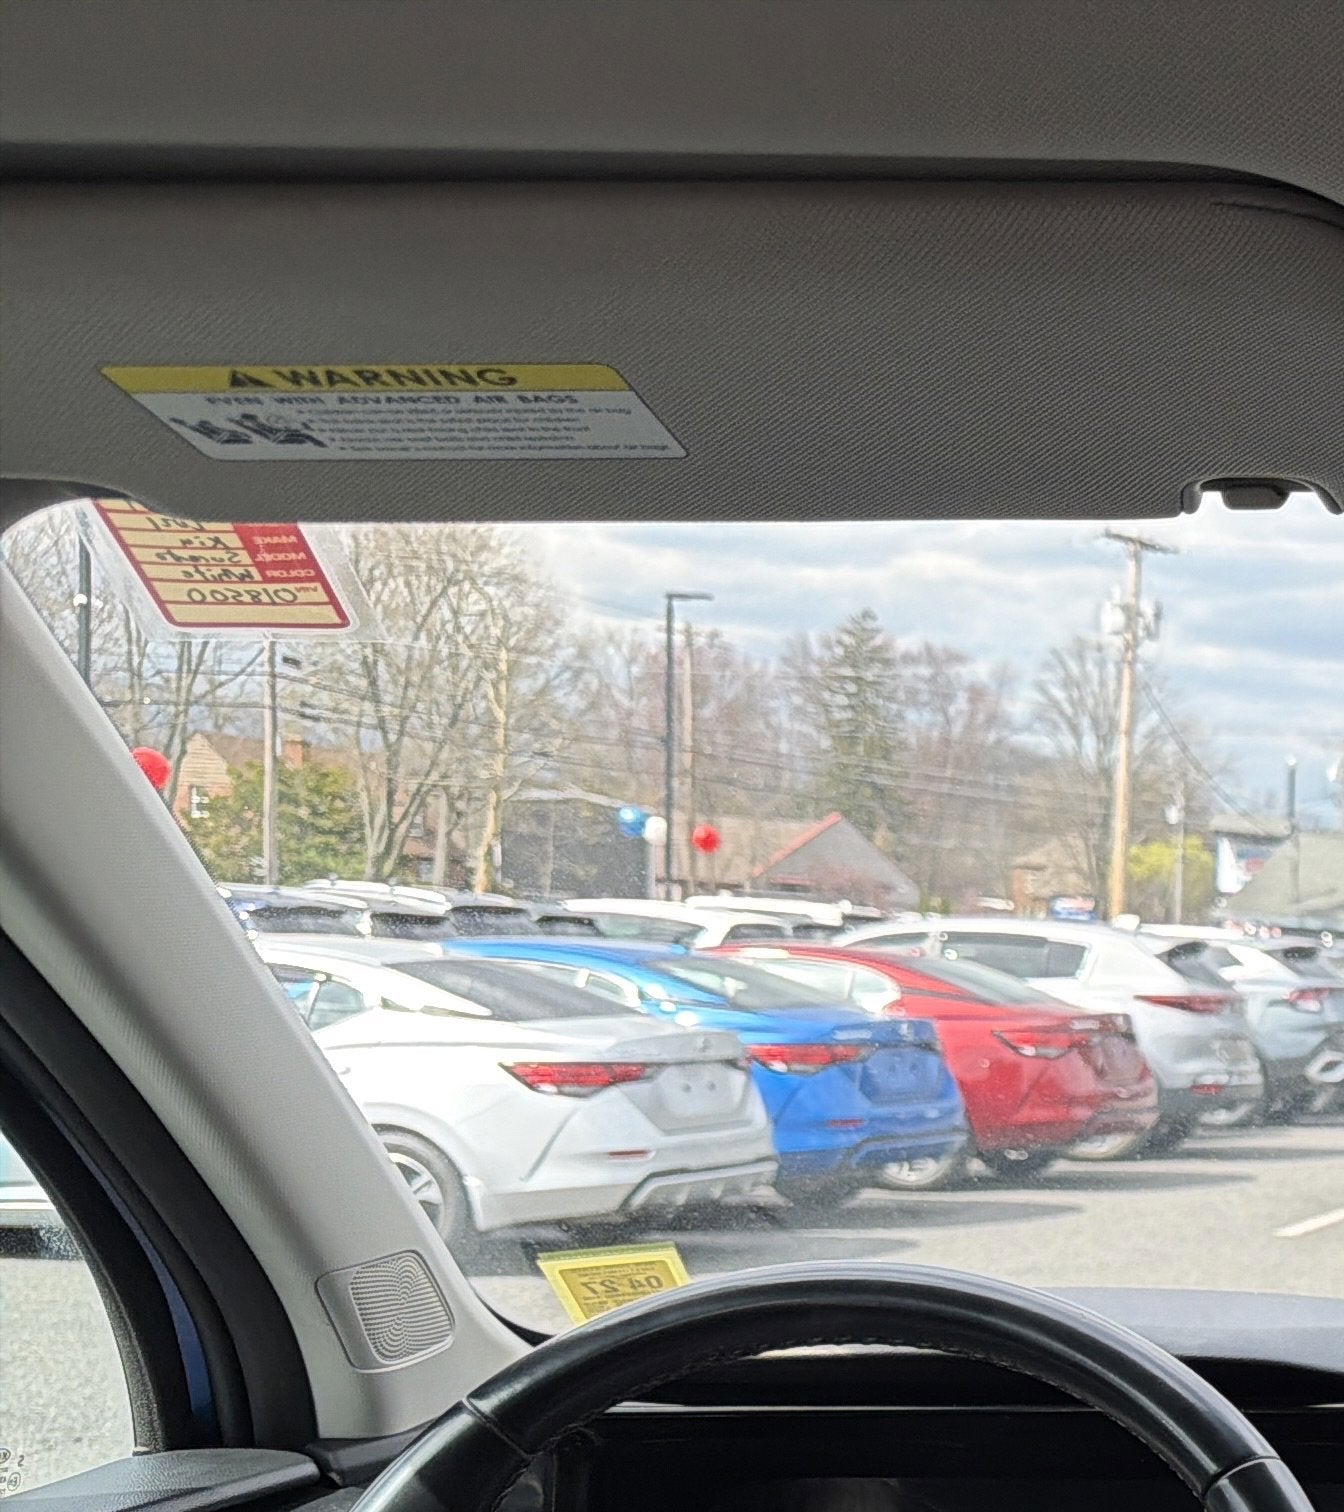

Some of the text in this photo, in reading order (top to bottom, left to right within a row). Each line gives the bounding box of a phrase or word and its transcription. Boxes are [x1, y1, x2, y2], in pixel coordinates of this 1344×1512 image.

[272, 368, 518, 387] WARNING
[336, 395, 461, 405] ADVANCED
[472, 394, 505, 404] AIR
[516, 395, 579, 404] BAGS
